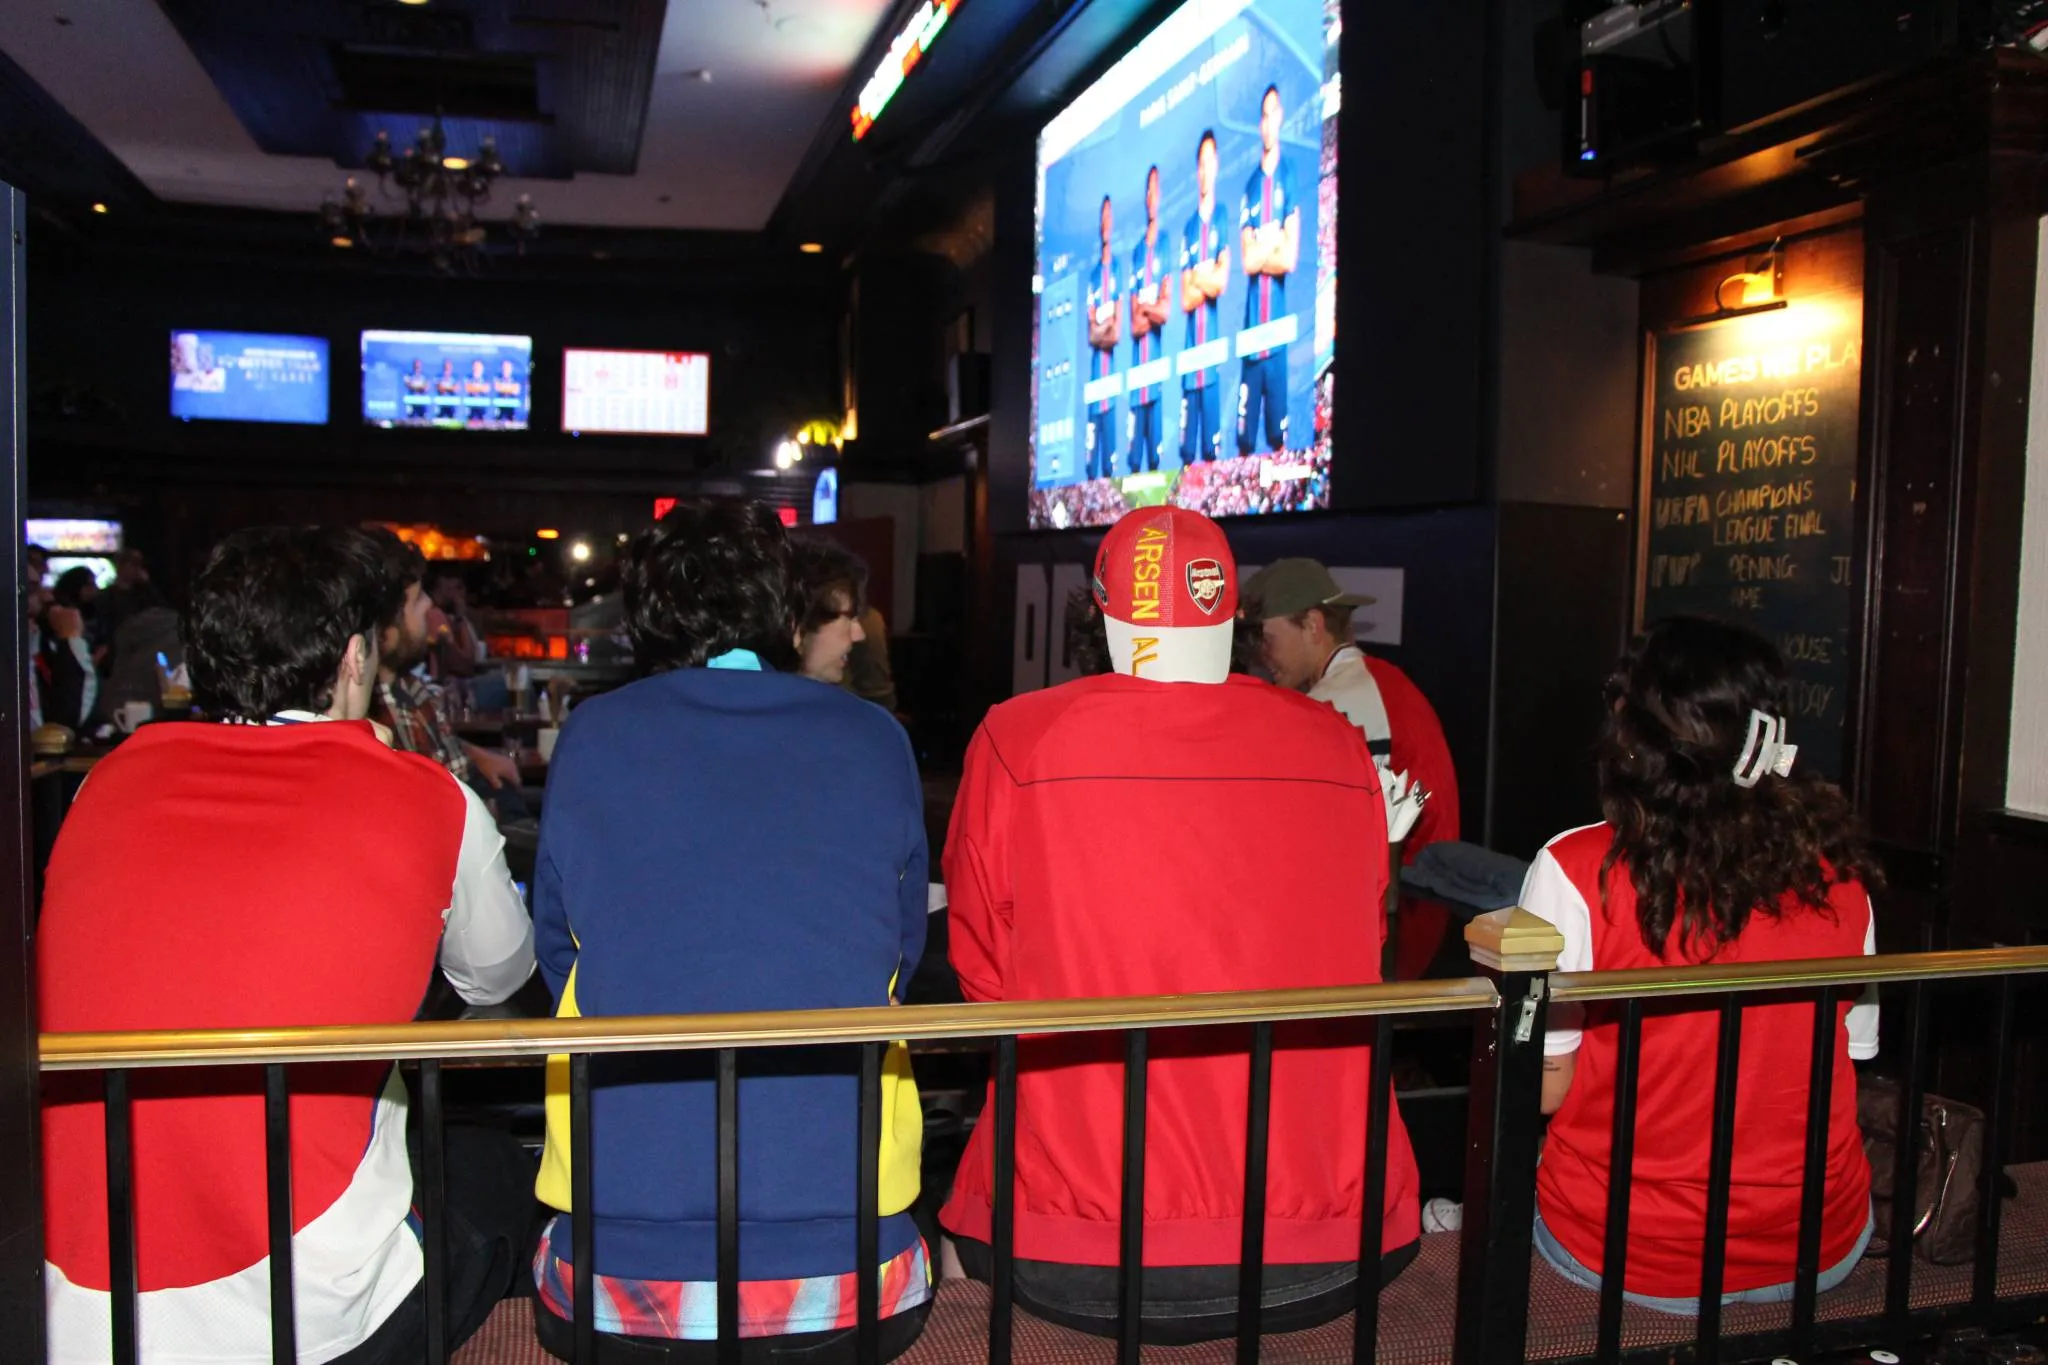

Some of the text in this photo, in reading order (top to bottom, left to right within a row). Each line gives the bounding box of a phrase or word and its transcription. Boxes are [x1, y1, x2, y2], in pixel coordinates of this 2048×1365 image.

[1675, 356, 1756, 391] GAMES
[1665, 389, 1819, 440] NBA PLAYOFFS
[1662, 437, 1817, 481] NHL PLAYOFFS
[1716, 481, 1813, 517] CHAMPIONS
[1713, 510, 1827, 546] LEAGUE FINAL
